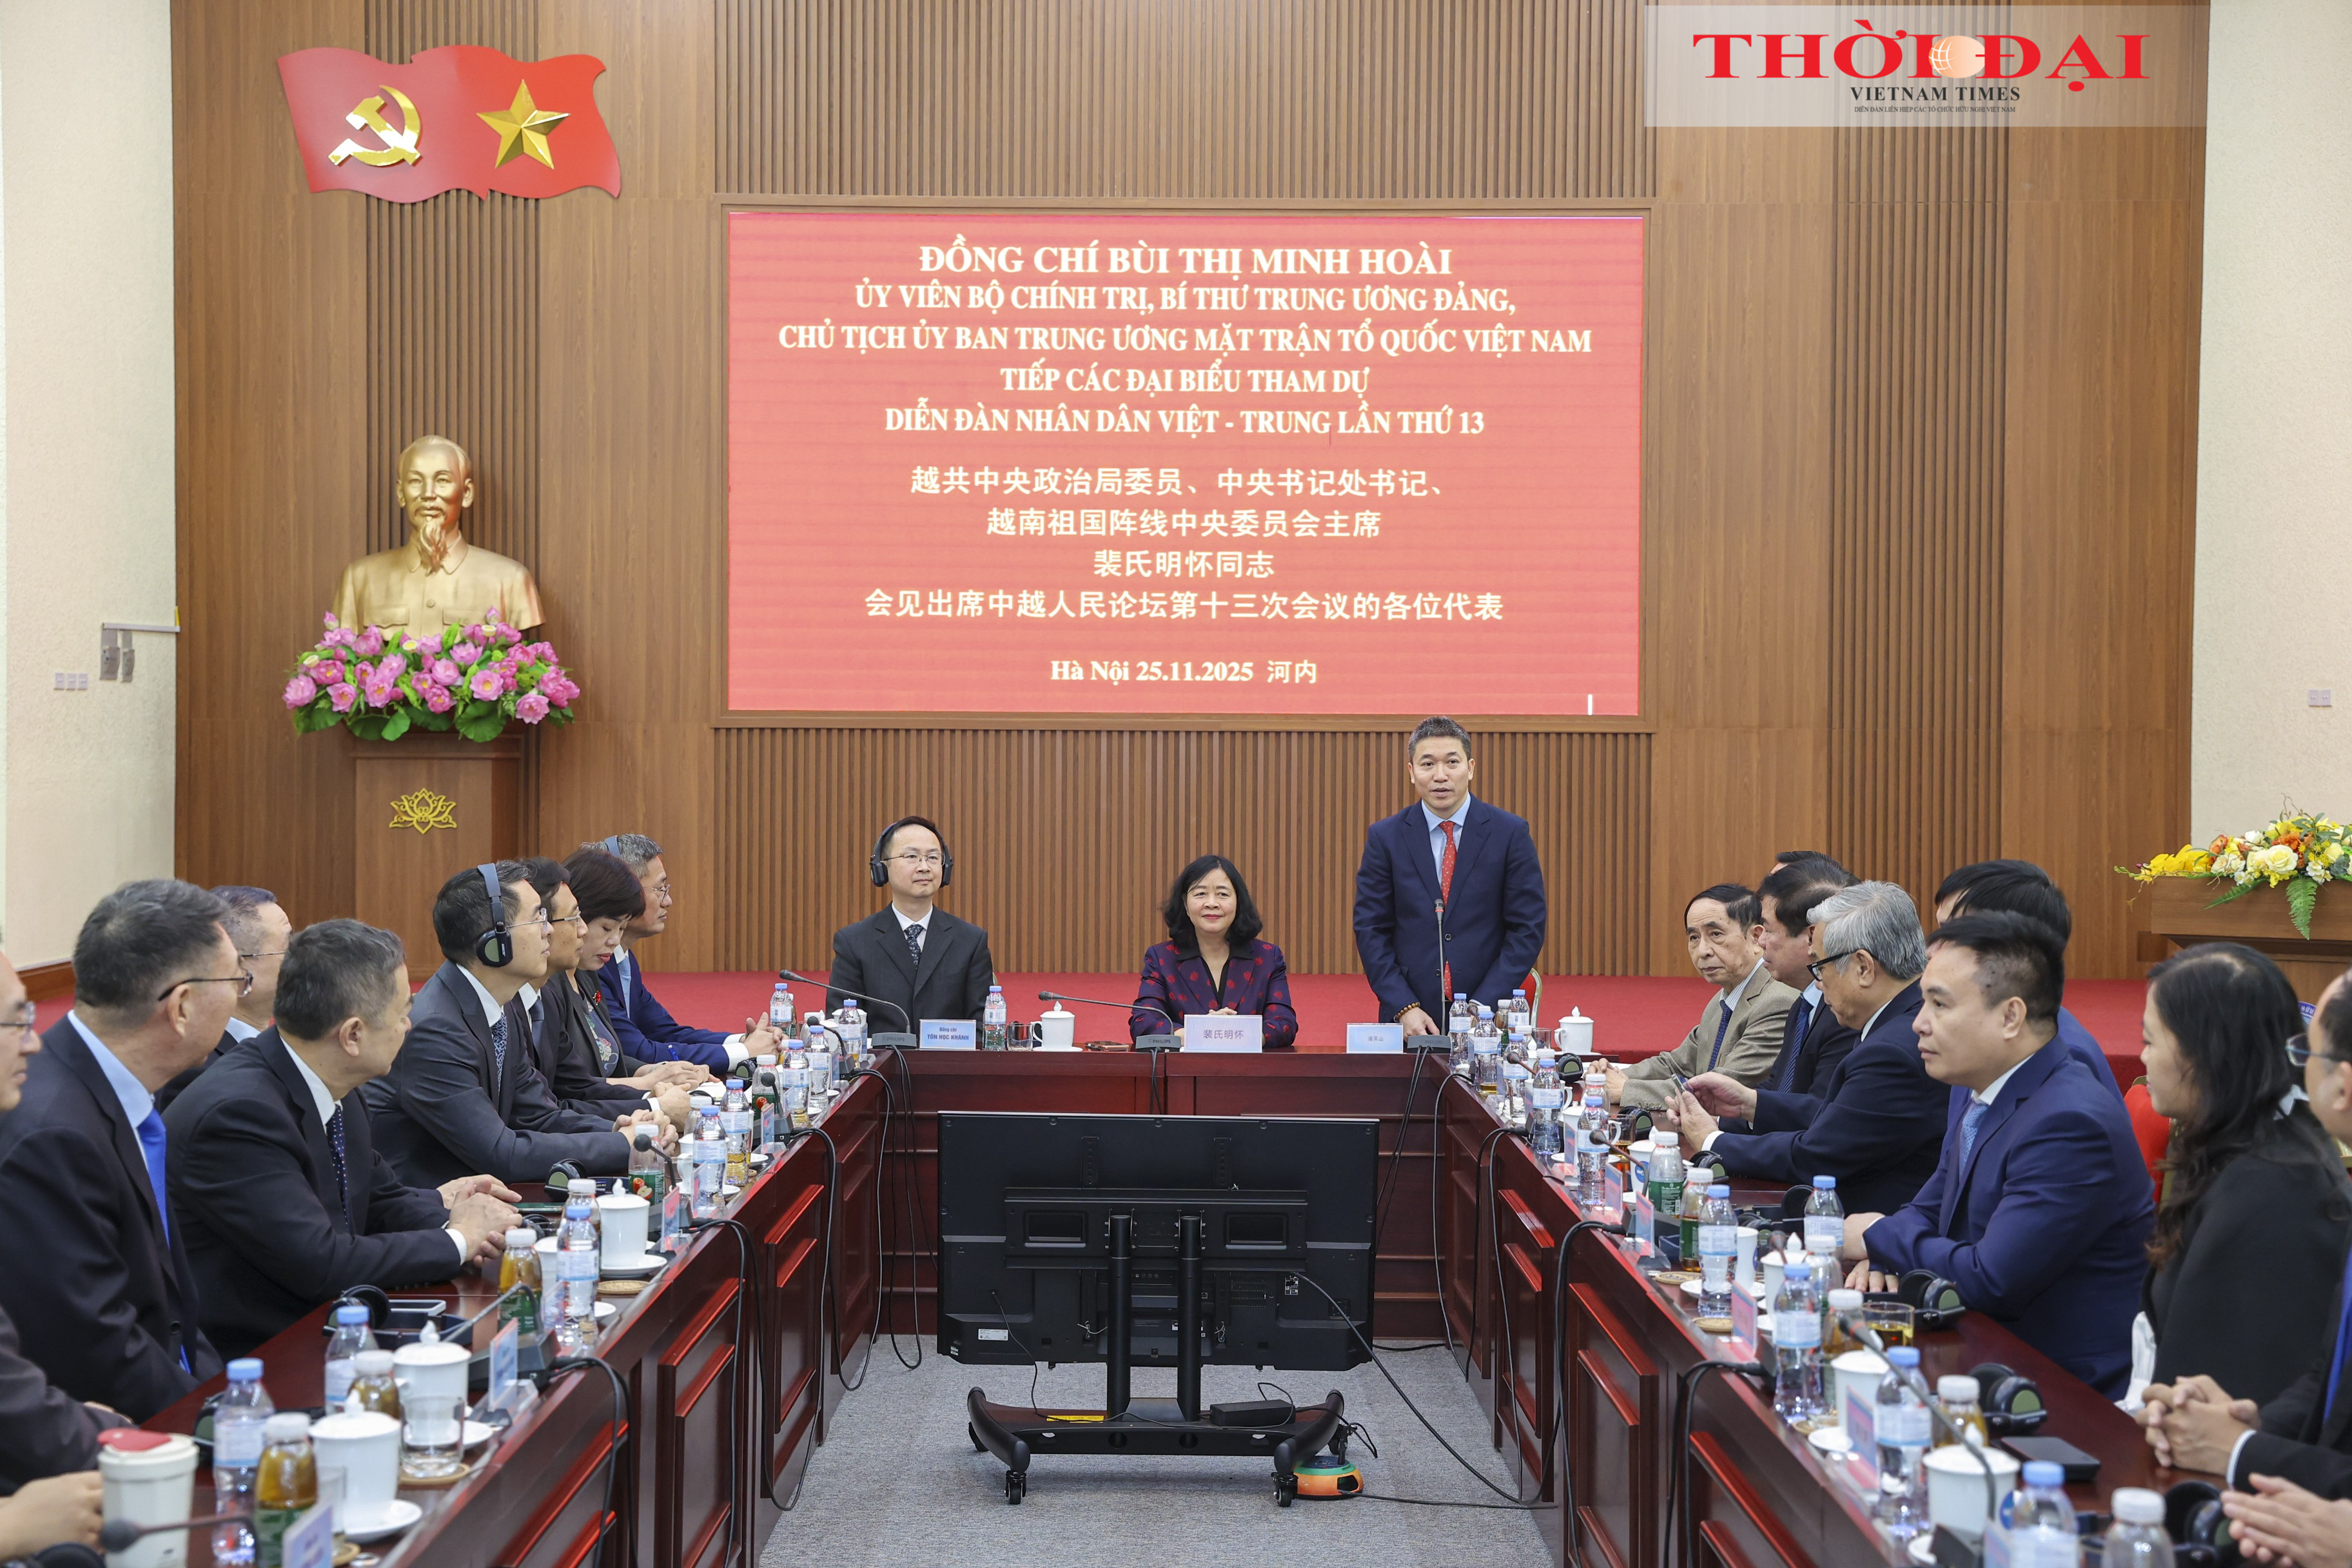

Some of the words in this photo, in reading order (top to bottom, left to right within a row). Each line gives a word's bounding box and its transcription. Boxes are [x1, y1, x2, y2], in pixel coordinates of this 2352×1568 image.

[919, 233, 1024, 273] ĐỒNG
[1034, 239, 1099, 273] CHÍ
[1107, 239, 1170, 274] BÙI
[1178, 248, 1243, 282] THỊ
[1251, 248, 1351, 275] MINH
[1358, 240, 1452, 275] HOÀI
[855, 277, 892, 308] ỦY
[897, 278, 962, 308] VIÊN
[967, 279, 1005, 315] BỘ
[1010, 279, 1097, 309] CHÍNH
[1102, 286, 1155, 316] TRỊ,
[1159, 280, 1188, 310] BÍ
[1192, 284, 1250, 311] THƯ
[1253, 288, 1346, 311] TRUNG
[1351, 284, 1428, 311] ƯƠNG
[1433, 280, 1516, 316] ĐẢNG,
[778, 318, 835, 349] CHỦ
[841, 326, 906, 355] TỊCH
[912, 318, 949, 349] ỦY
[955, 326, 1008, 349] BAN
[1014, 327, 1106, 351] TRUNG
[1112, 324, 1188, 351] ƯƠNG
[1193, 322, 1254, 357] MẶT
[1259, 322, 1331, 358] TRẬN
[1337, 317, 1375, 352] TỔ
[1380, 318, 1456, 357] QUỐC
[1462, 322, 1525, 358] VIỆT
[1531, 329, 1592, 353] NAM
[1000, 357, 1061, 391] TIẾP
[1066, 361, 1121, 392] CÁC
[1126, 369, 1173, 398] ĐẠI
[1179, 358, 1242, 393] BIỂU
[1247, 369, 1326, 393] THAM
[1332, 366, 1370, 399] DỰ
[885, 397, 948, 431] DIỄN
[954, 401, 1010, 431] ĐÀN
[1015, 402, 1090, 432] NHÂN
[1096, 402, 1152, 433] DÂN
[1157, 403, 1219, 439] VIỆT
[1240, 410, 1331, 434] TRUNG
[1337, 400, 1391, 434] LẦN
[1396, 404, 1453, 435] THỨ
[1459, 411, 1484, 435] 13
[986, 507, 1381, 538] 越南祖国阵线中央委员会主席
[1093, 549, 1275, 578] 裴氏明怀同志
[865, 588, 1504, 621] 会见出席中越人民论坛第十三次会议的各位代表
[1051, 660, 1084, 680] Hà
[1090, 660, 1130, 686] Nội
[1135, 661, 1253, 681] 25.11.2025
[1267, 659, 1317, 684] 河内
[1203, 1030, 1244, 1039] 裴氏明怀
